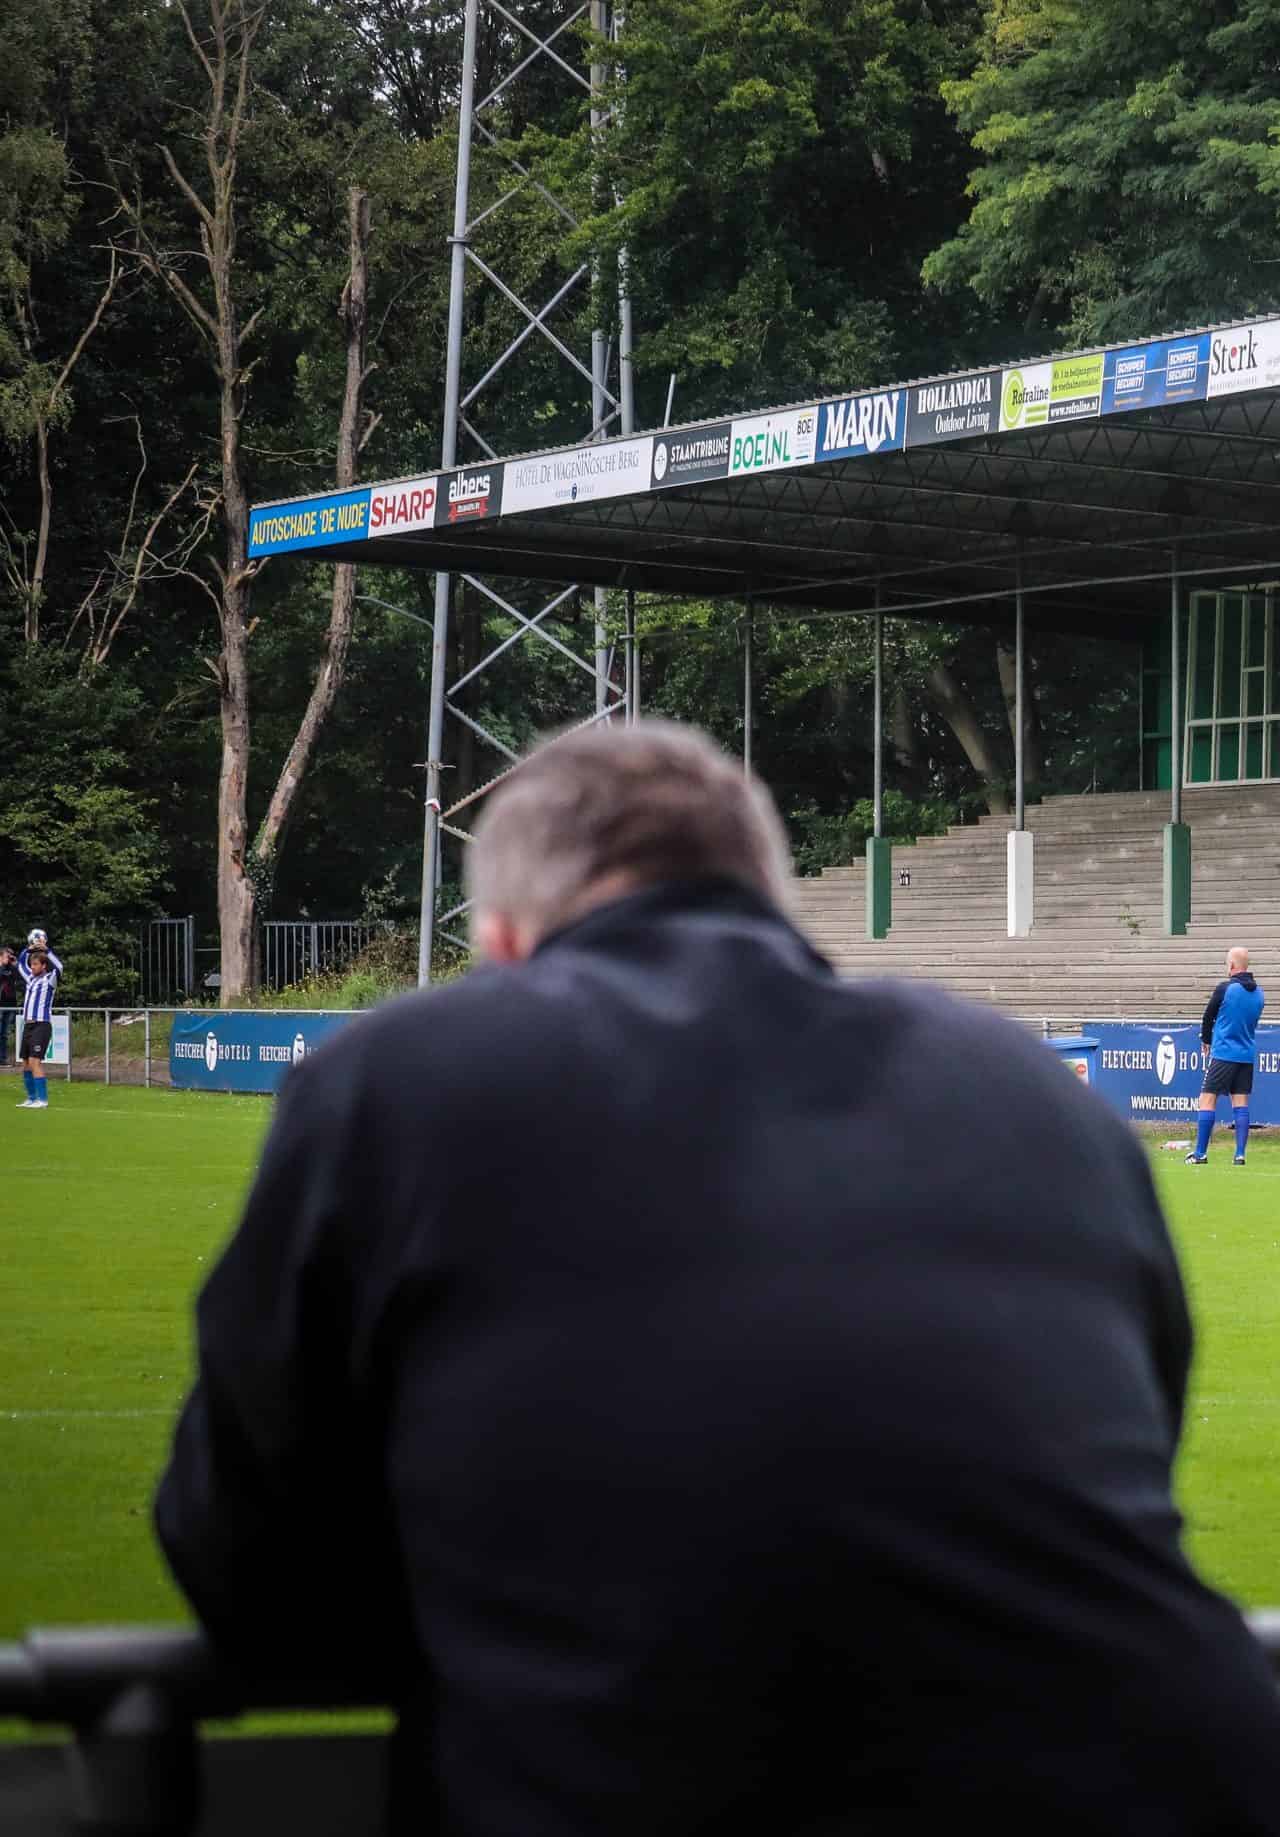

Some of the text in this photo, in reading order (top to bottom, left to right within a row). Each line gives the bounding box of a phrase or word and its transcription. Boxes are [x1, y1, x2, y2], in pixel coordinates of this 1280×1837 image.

[1211, 330, 1258, 377] Sterk
[917, 377, 992, 414] HOLLANDICA
[1012, 384, 1049, 406] Rofraline
[823, 392, 899, 451] MARIN
[935, 409, 990, 434] Outdoor Living
[617, 449, 640, 471] BERG
[670, 437, 729, 463] STAANTRIBUNE
[370, 488, 435, 528] SHARP
[251, 511, 317, 546] AUTOSCHADE
[175, 1042, 251, 1061] FLETCHER HOTELS
[259, 1045, 292, 1062] FLETCHER
[1102, 1051, 1153, 1070] FLETCHER
